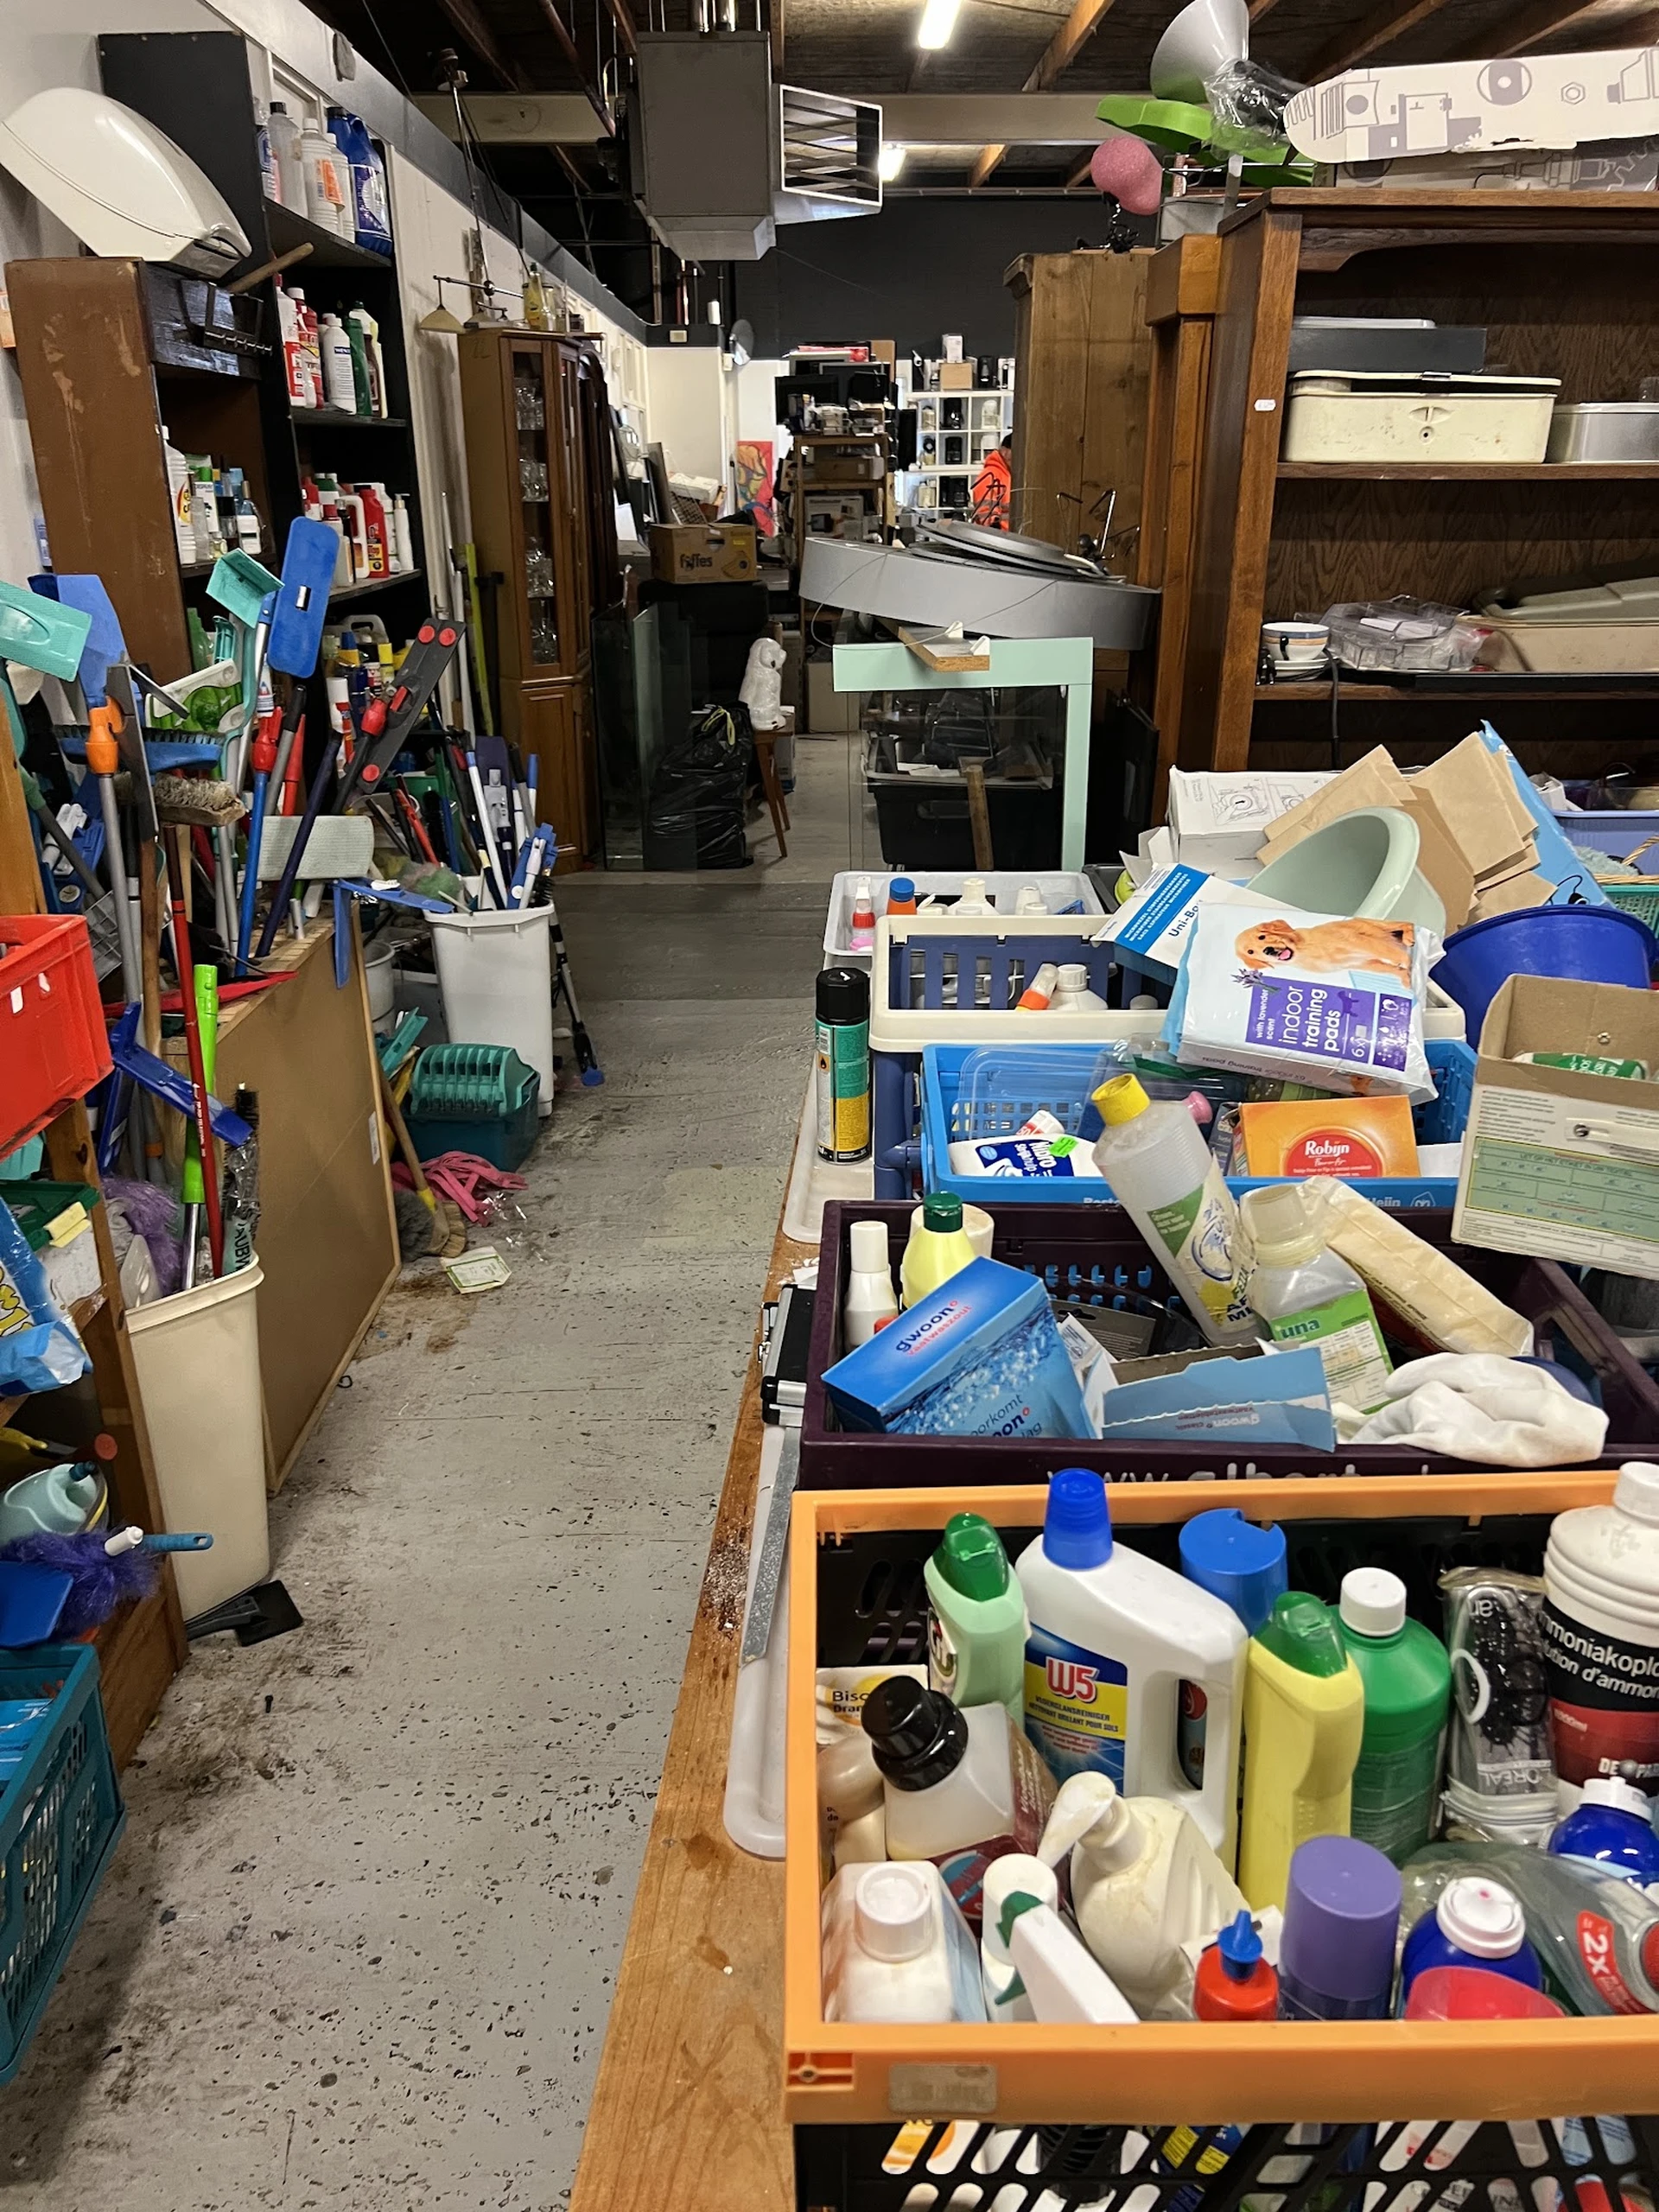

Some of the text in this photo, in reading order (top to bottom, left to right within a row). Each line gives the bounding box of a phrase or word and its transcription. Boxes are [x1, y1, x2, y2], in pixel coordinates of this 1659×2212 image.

[1168, 899, 1203, 937] Uni-Bo
[1255, 988, 1268, 1039] with lavender
[1266, 1018, 1276, 1039] scent
[1278, 986, 1304, 1045] indoor
[1302, 988, 1328, 1048] training
[1324, 1009, 1341, 1052] pads
[1305, 1140, 1350, 1157] Robijn
[896, 1306, 956, 1352] gwoon
[907, 1305, 972, 1357] vaatwaszout
[1281, 1319, 1320, 1338] una
[1212, 1413, 1260, 1427] gwoon
[1046, 1656, 1098, 1702] W5
[1058, 1713, 1084, 1726] BRILLANT
[1086, 1720, 1103, 1729] POUR
[1103, 1724, 1119, 1732] SOLS
[1599, 1758, 1619, 1775] DE
